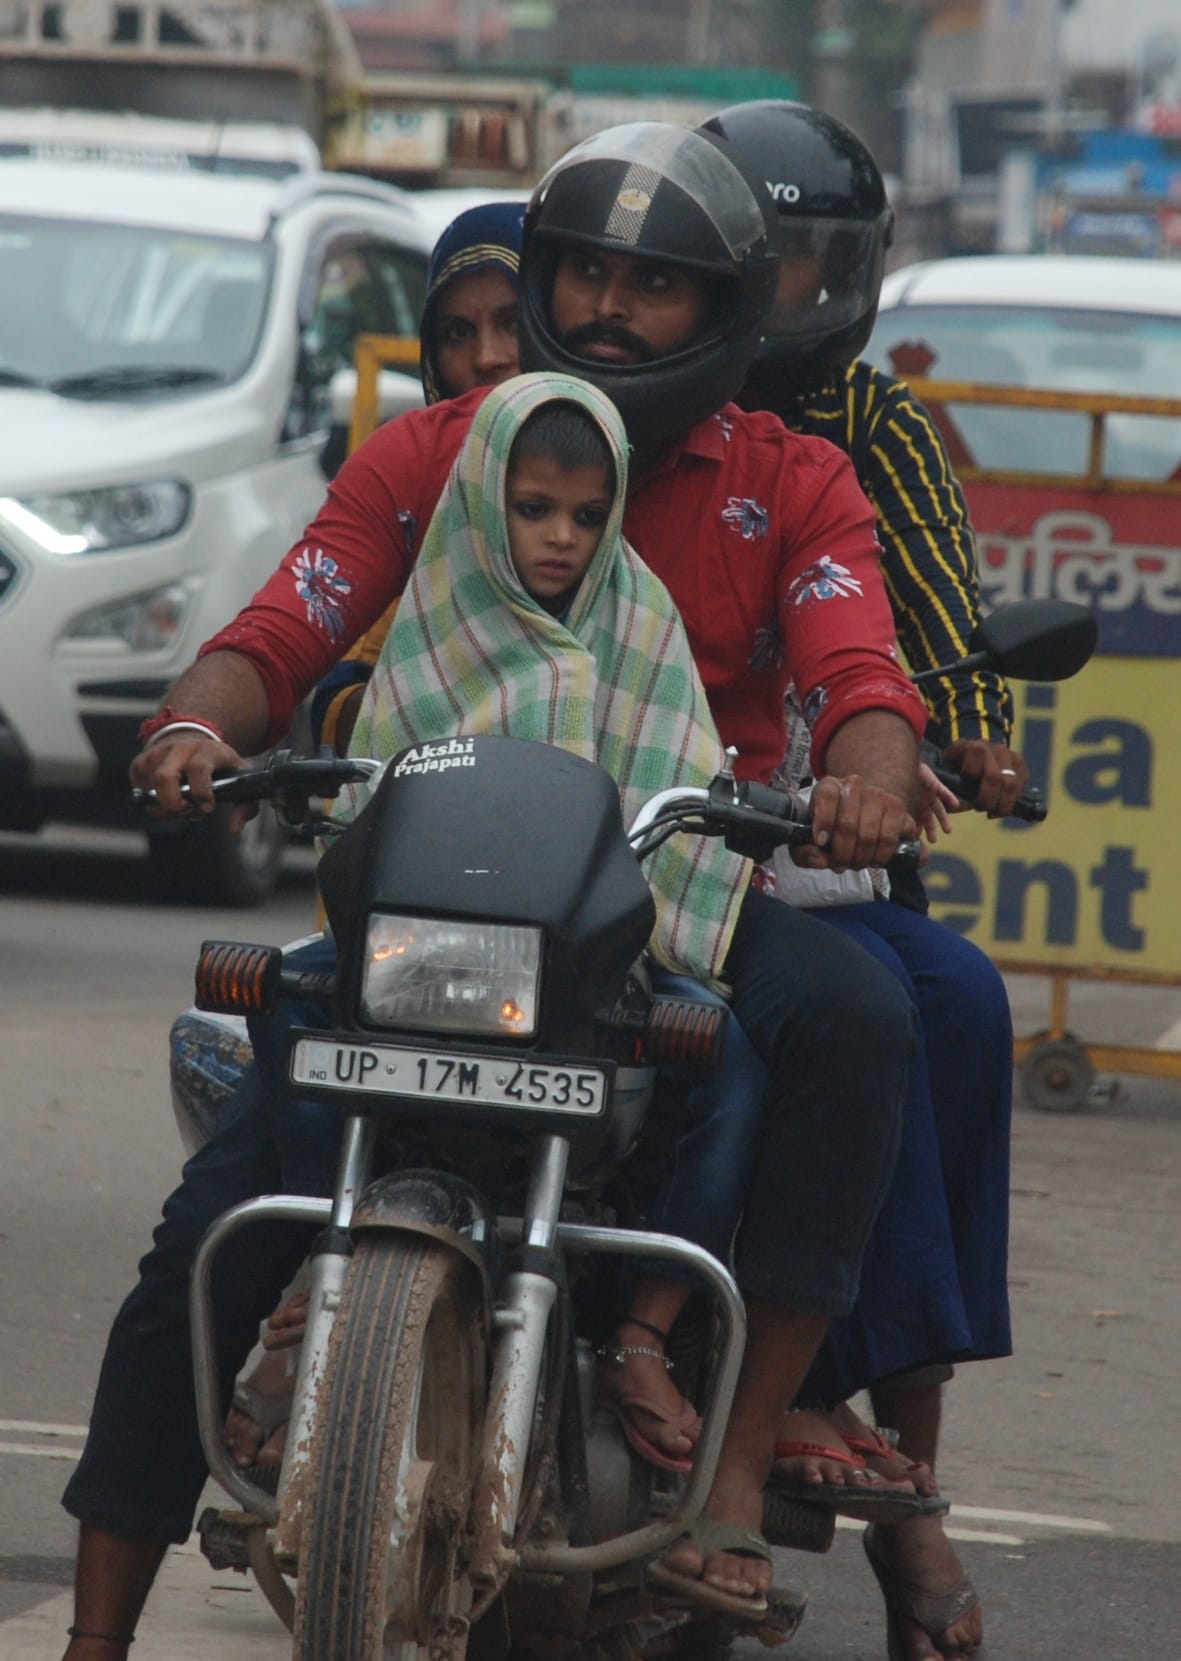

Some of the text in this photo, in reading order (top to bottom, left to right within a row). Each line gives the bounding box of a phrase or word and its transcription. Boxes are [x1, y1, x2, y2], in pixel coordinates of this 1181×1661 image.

[400, 738, 474, 765] Akshi
[394, 755, 476, 778] Prajapati
[308, 1069, 328, 1081] IND
[336, 1049, 379, 1084] UP
[417, 1057, 480, 1096] 17M
[504, 1062, 598, 1107] 4535
